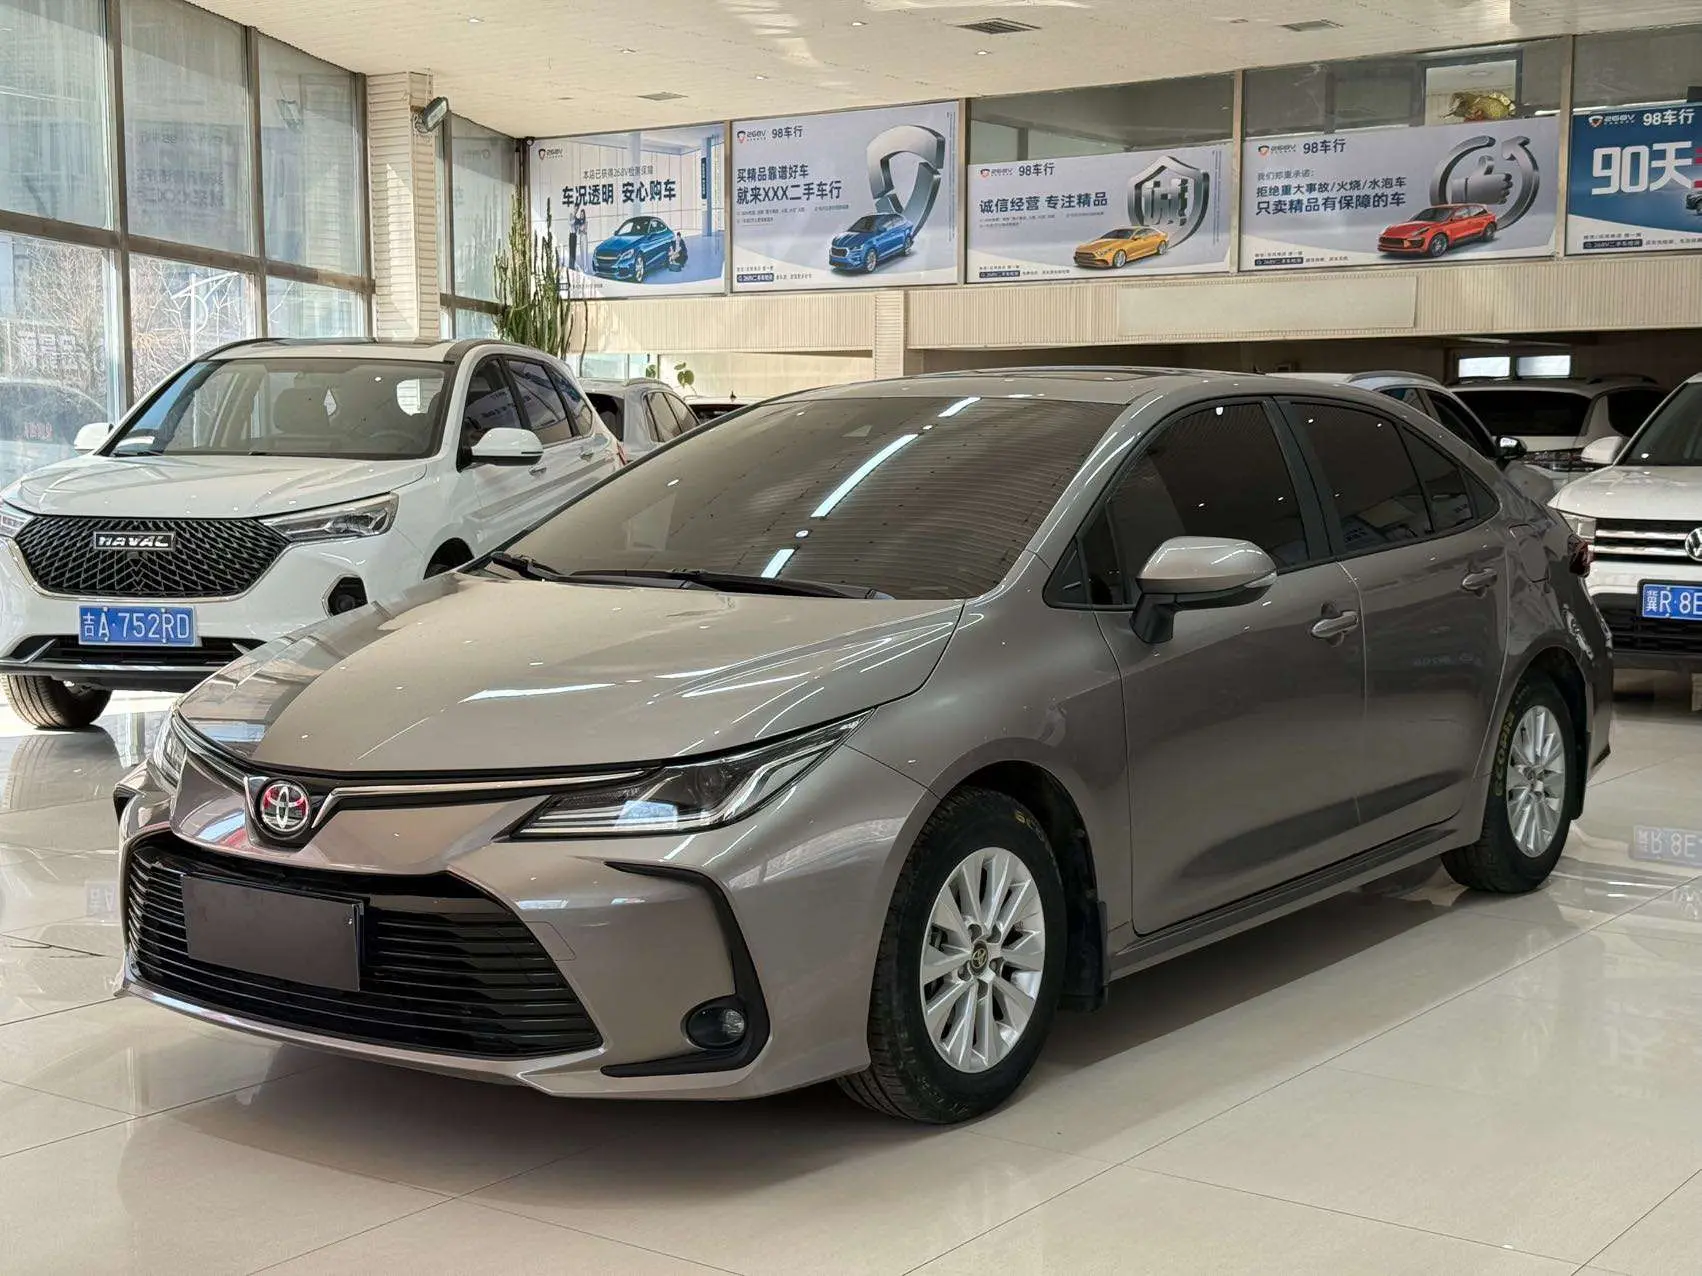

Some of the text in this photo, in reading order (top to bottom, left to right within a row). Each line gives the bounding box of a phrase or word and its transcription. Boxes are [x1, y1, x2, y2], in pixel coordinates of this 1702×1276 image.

[1643, 109, 1695, 126] 98车行
[771, 125, 803, 139] 98车行
[1303, 138, 1346, 154] 98车行
[736, 163, 809, 183] 买精品靠谱好车
[1018, 162, 1055, 177] 98车行
[1591, 140, 1702, 196] 90天
[562, 183, 615, 207] 车况透明
[621, 178, 677, 204] 安心购车
[736, 180, 842, 206] 就来XXX二手车行
[1256, 175, 1407, 199] 拒绝重大事故/火烧/水泡车
[979, 190, 1109, 214] 诚信经营 专注精品
[1255, 191, 1407, 217] 只卖精品有保障的车
[98, 535, 169, 548] HAVAL
